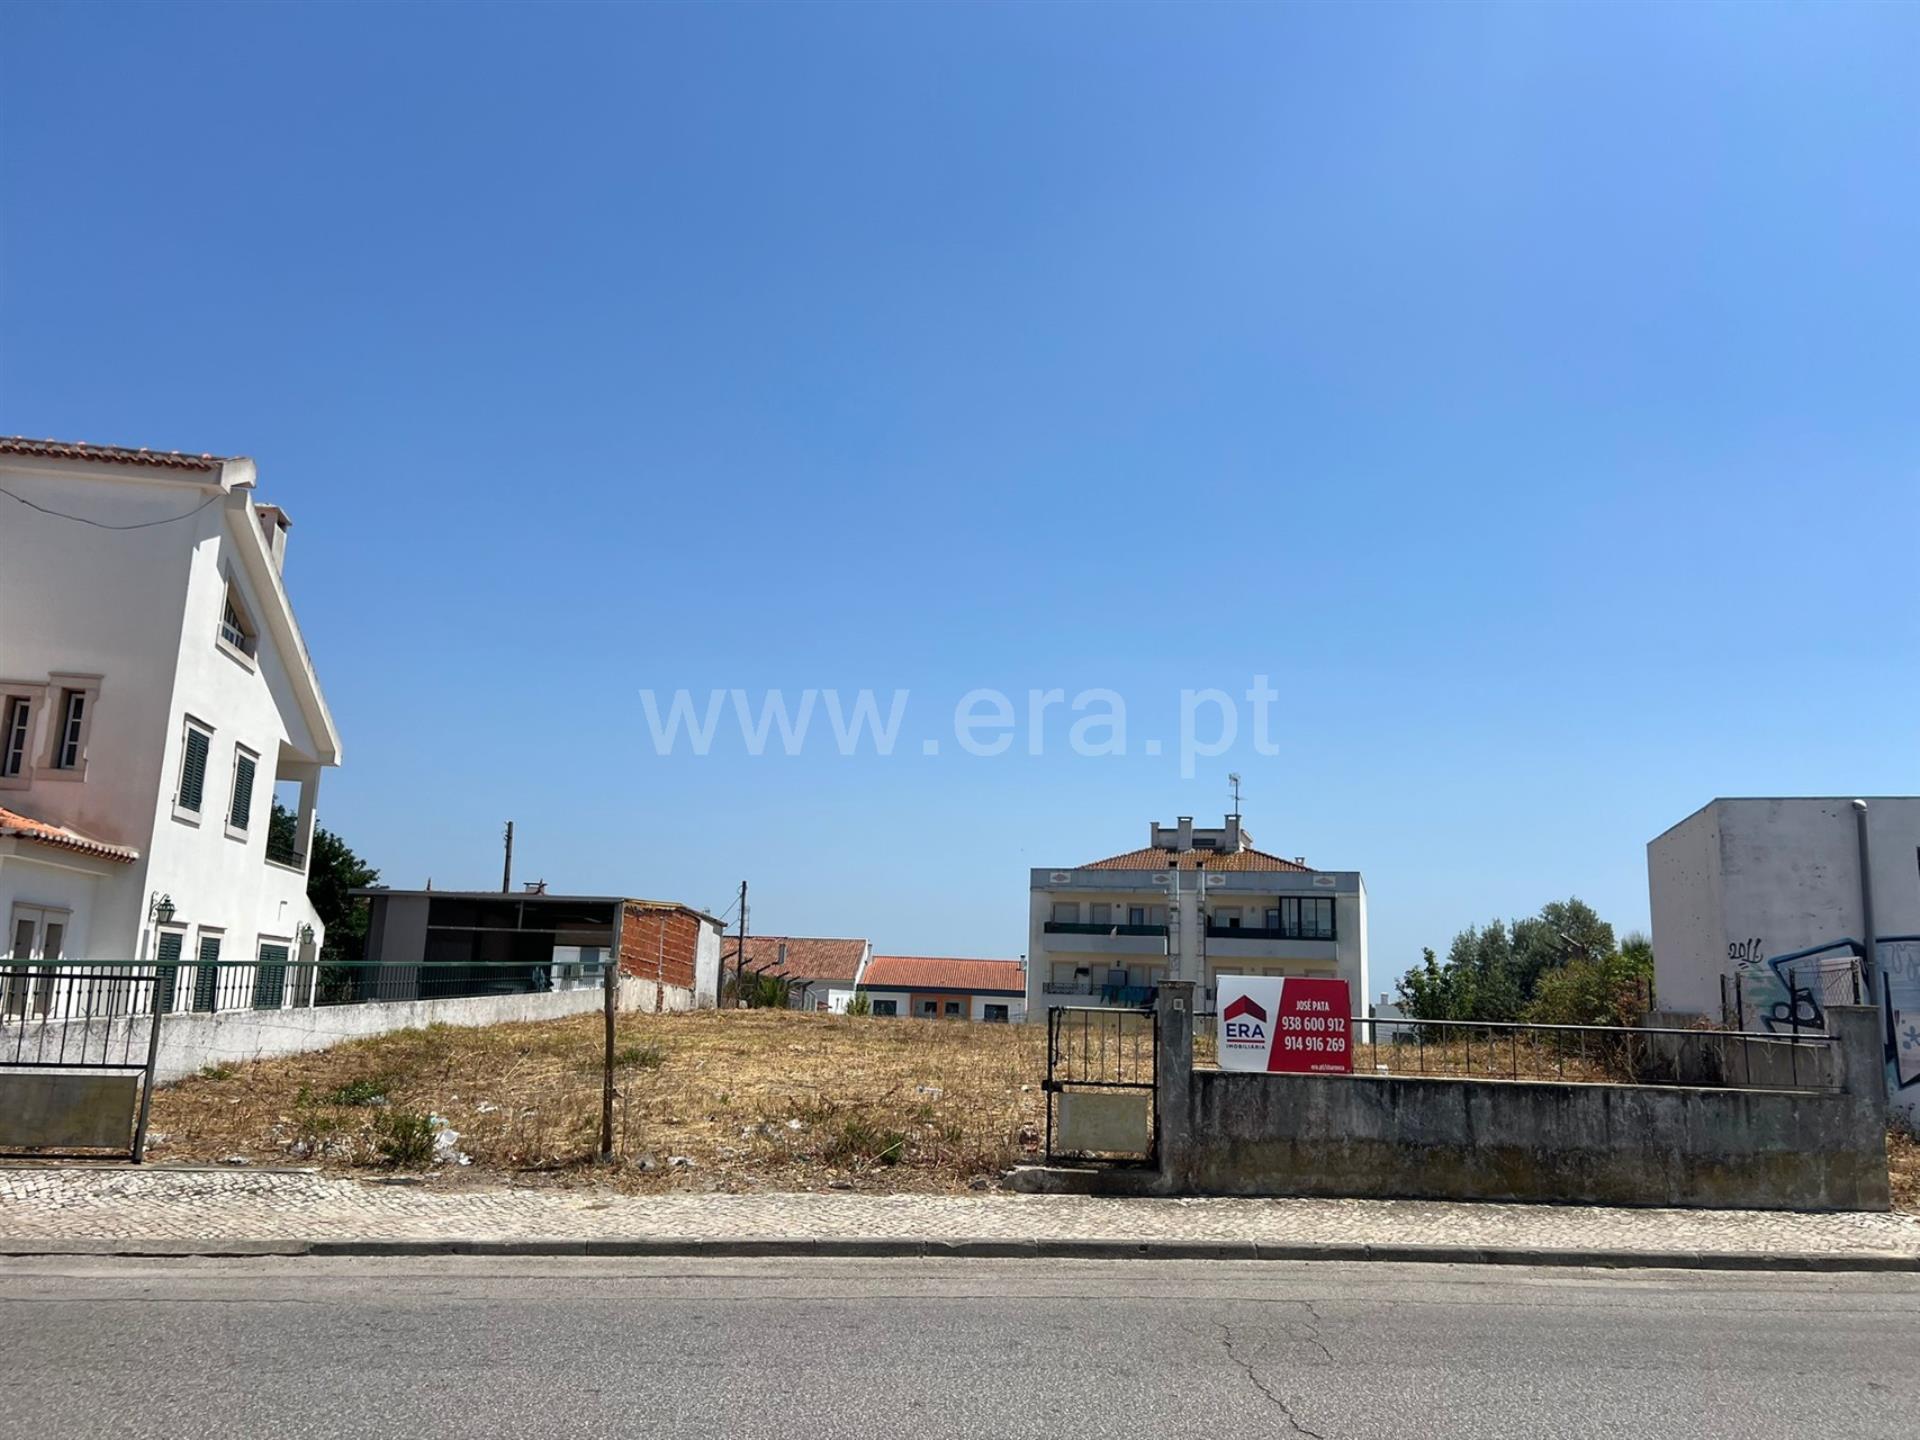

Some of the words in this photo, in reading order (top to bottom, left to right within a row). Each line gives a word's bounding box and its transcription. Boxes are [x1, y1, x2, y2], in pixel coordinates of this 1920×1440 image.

[1296, 998, 1311, 1010] JOSÉ
[1312, 1001, 1329, 1011] PATA
[1226, 1023, 1265, 1038] ERA
[1282, 1016, 1301, 1030] 938
[1304, 1017, 1325, 1031] 600
[1327, 1018, 1345, 1032] 912
[1284, 1036, 1303, 1050] 914
[1305, 1036, 1324, 1051] 916
[1326, 1037, 1345, 1052] 269
